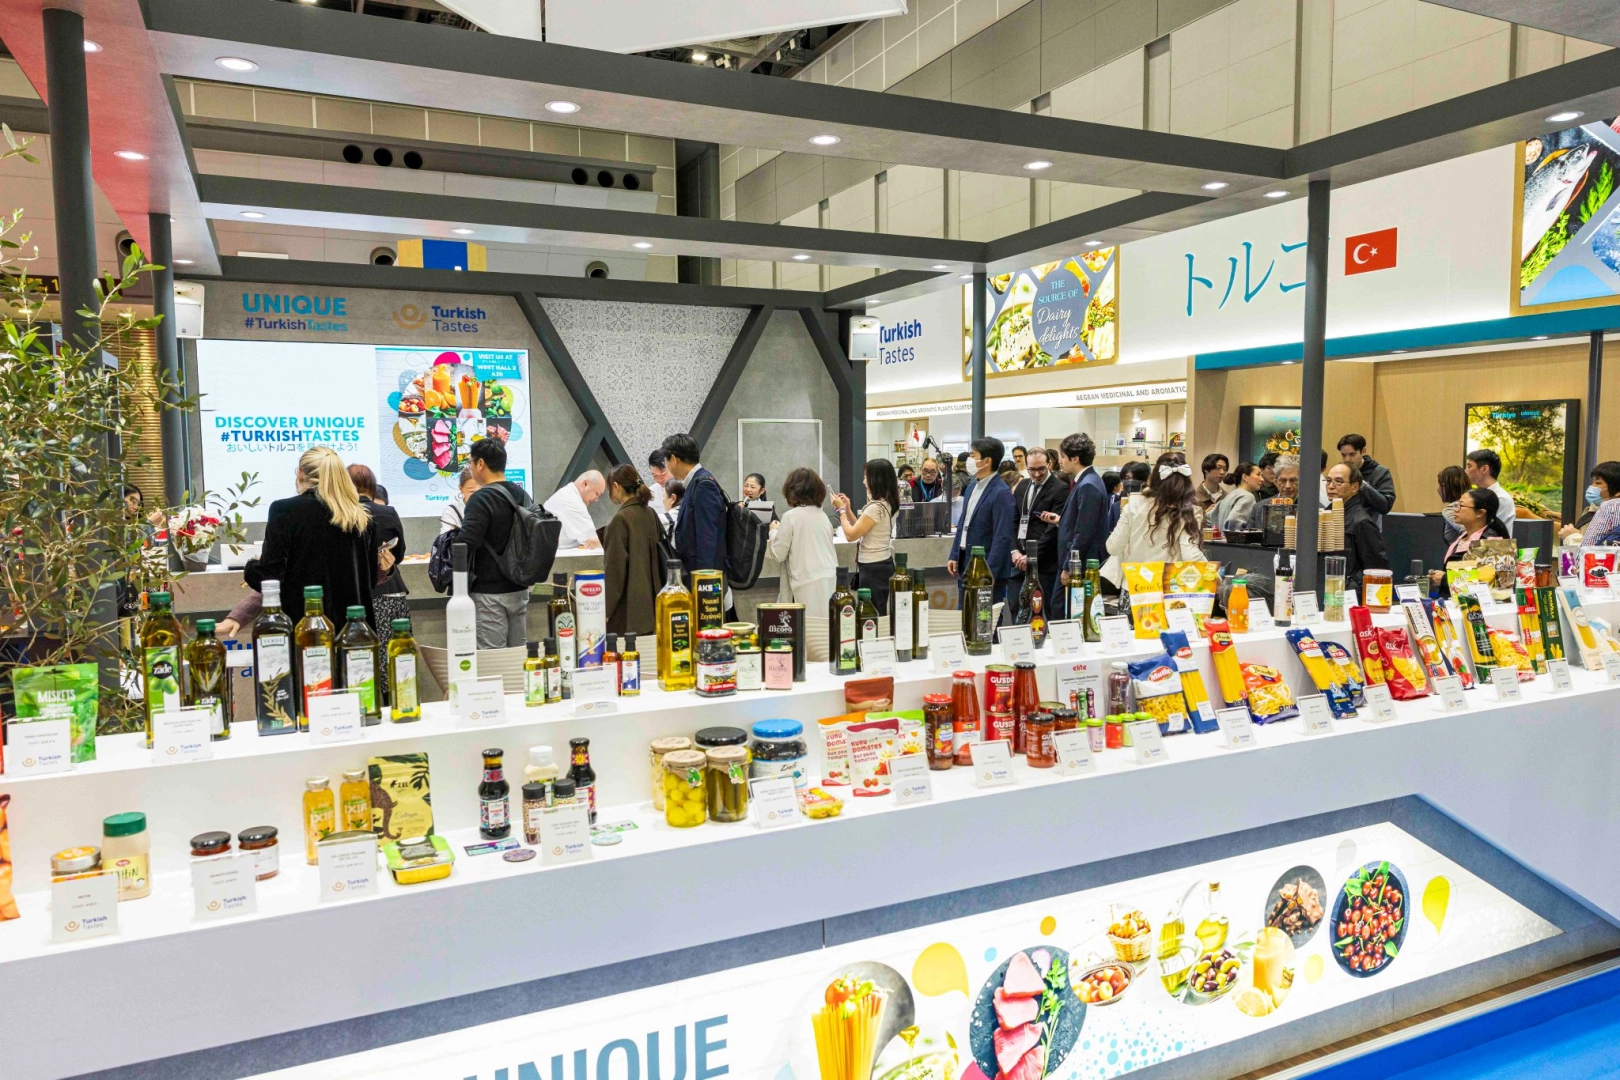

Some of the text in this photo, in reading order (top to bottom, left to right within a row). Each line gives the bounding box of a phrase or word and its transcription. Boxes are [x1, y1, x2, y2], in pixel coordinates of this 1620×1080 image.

[1050, 279, 1065, 290] THE
[1038, 288, 1078, 304] SOURCE OF
[242, 293, 348, 316] UNIQUE
[431, 305, 486, 320] Turkish
[1037, 306, 1072, 328] Dairy
[244, 317, 348, 332] #TurkishTastes
[431, 319, 478, 332] Tastes
[879, 318, 922, 344] Turkish
[1039, 323, 1080, 350] delights
[879, 346, 914, 366] Tastes
[1076, 386, 1187, 400] AEGEAN MEDICINAL AND AROMATIC
[215, 416, 364, 428] DISCOVER UNIQUE
[220, 430, 360, 442] #TURKISHTASTES
[154, 664, 172, 674] zade
[201, 695, 216, 704] zade
[463, 1014, 729, 1080] IQUE
